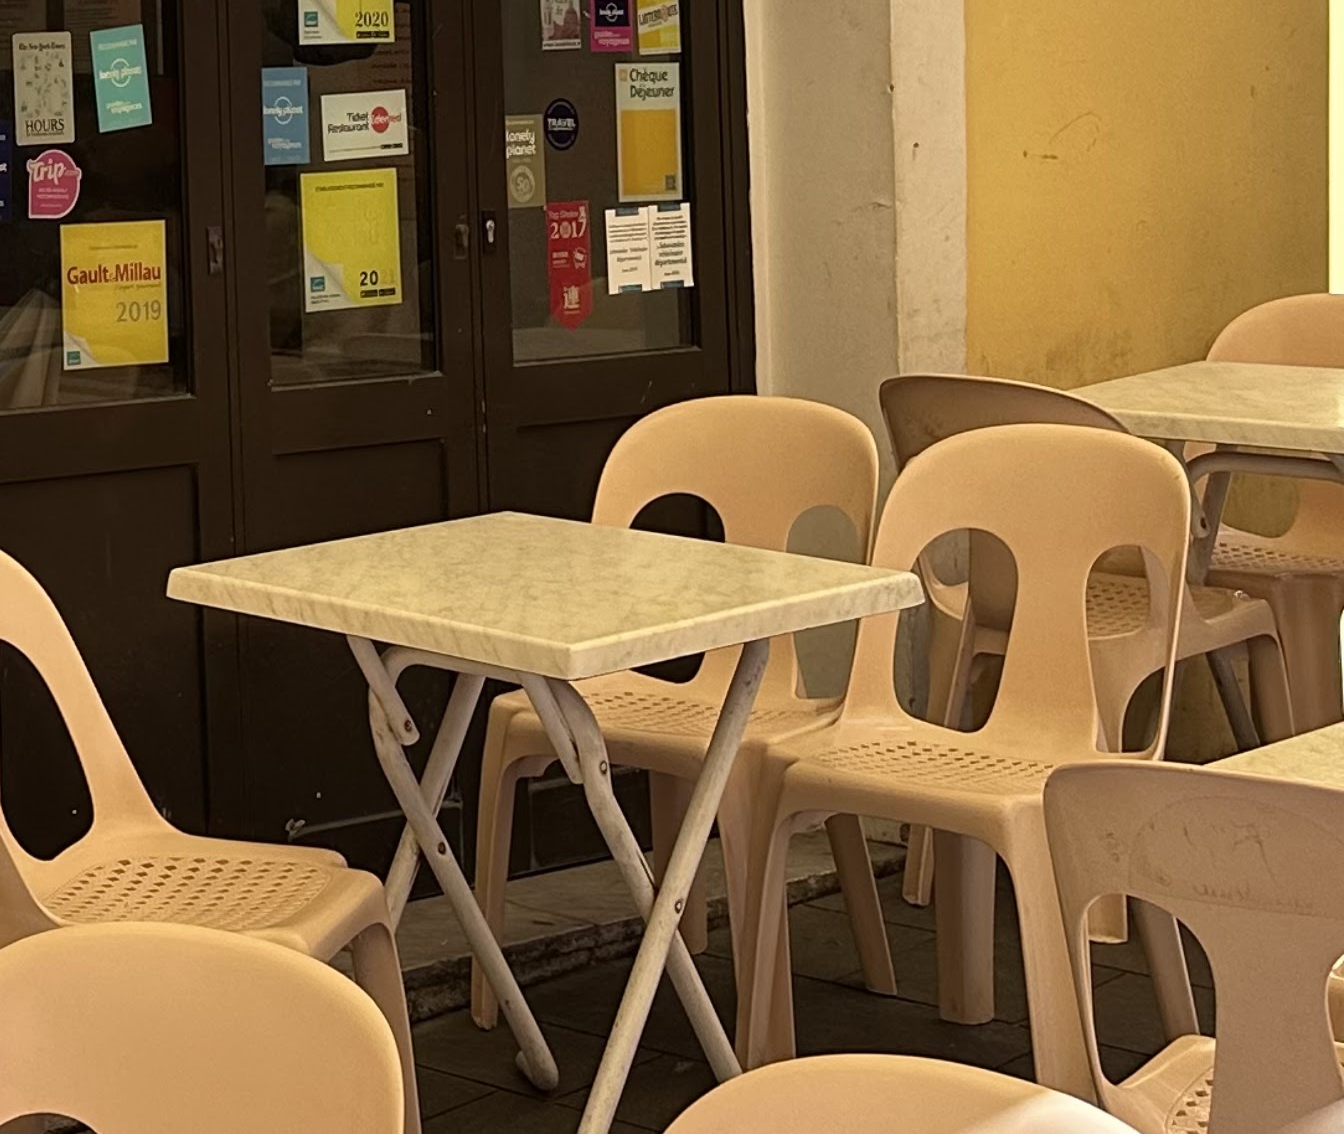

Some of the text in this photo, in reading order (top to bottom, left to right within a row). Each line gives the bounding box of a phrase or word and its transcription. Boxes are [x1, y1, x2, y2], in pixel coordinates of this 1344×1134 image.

[355, 11, 389, 27] 2020
[629, 68, 668, 84] Chèque
[630, 85, 674, 101] Déjeuner
[347, 112, 369, 122] Ticket
[25, 119, 64, 132] HOURS
[328, 123, 369, 135] Restaurant
[506, 129, 535, 144] lonely
[506, 144, 536, 159] planet
[29, 158, 66, 185] Trip
[550, 219, 587, 239] 2017
[67, 262, 161, 285] Gault Millau
[116, 300, 161, 322] 2019
